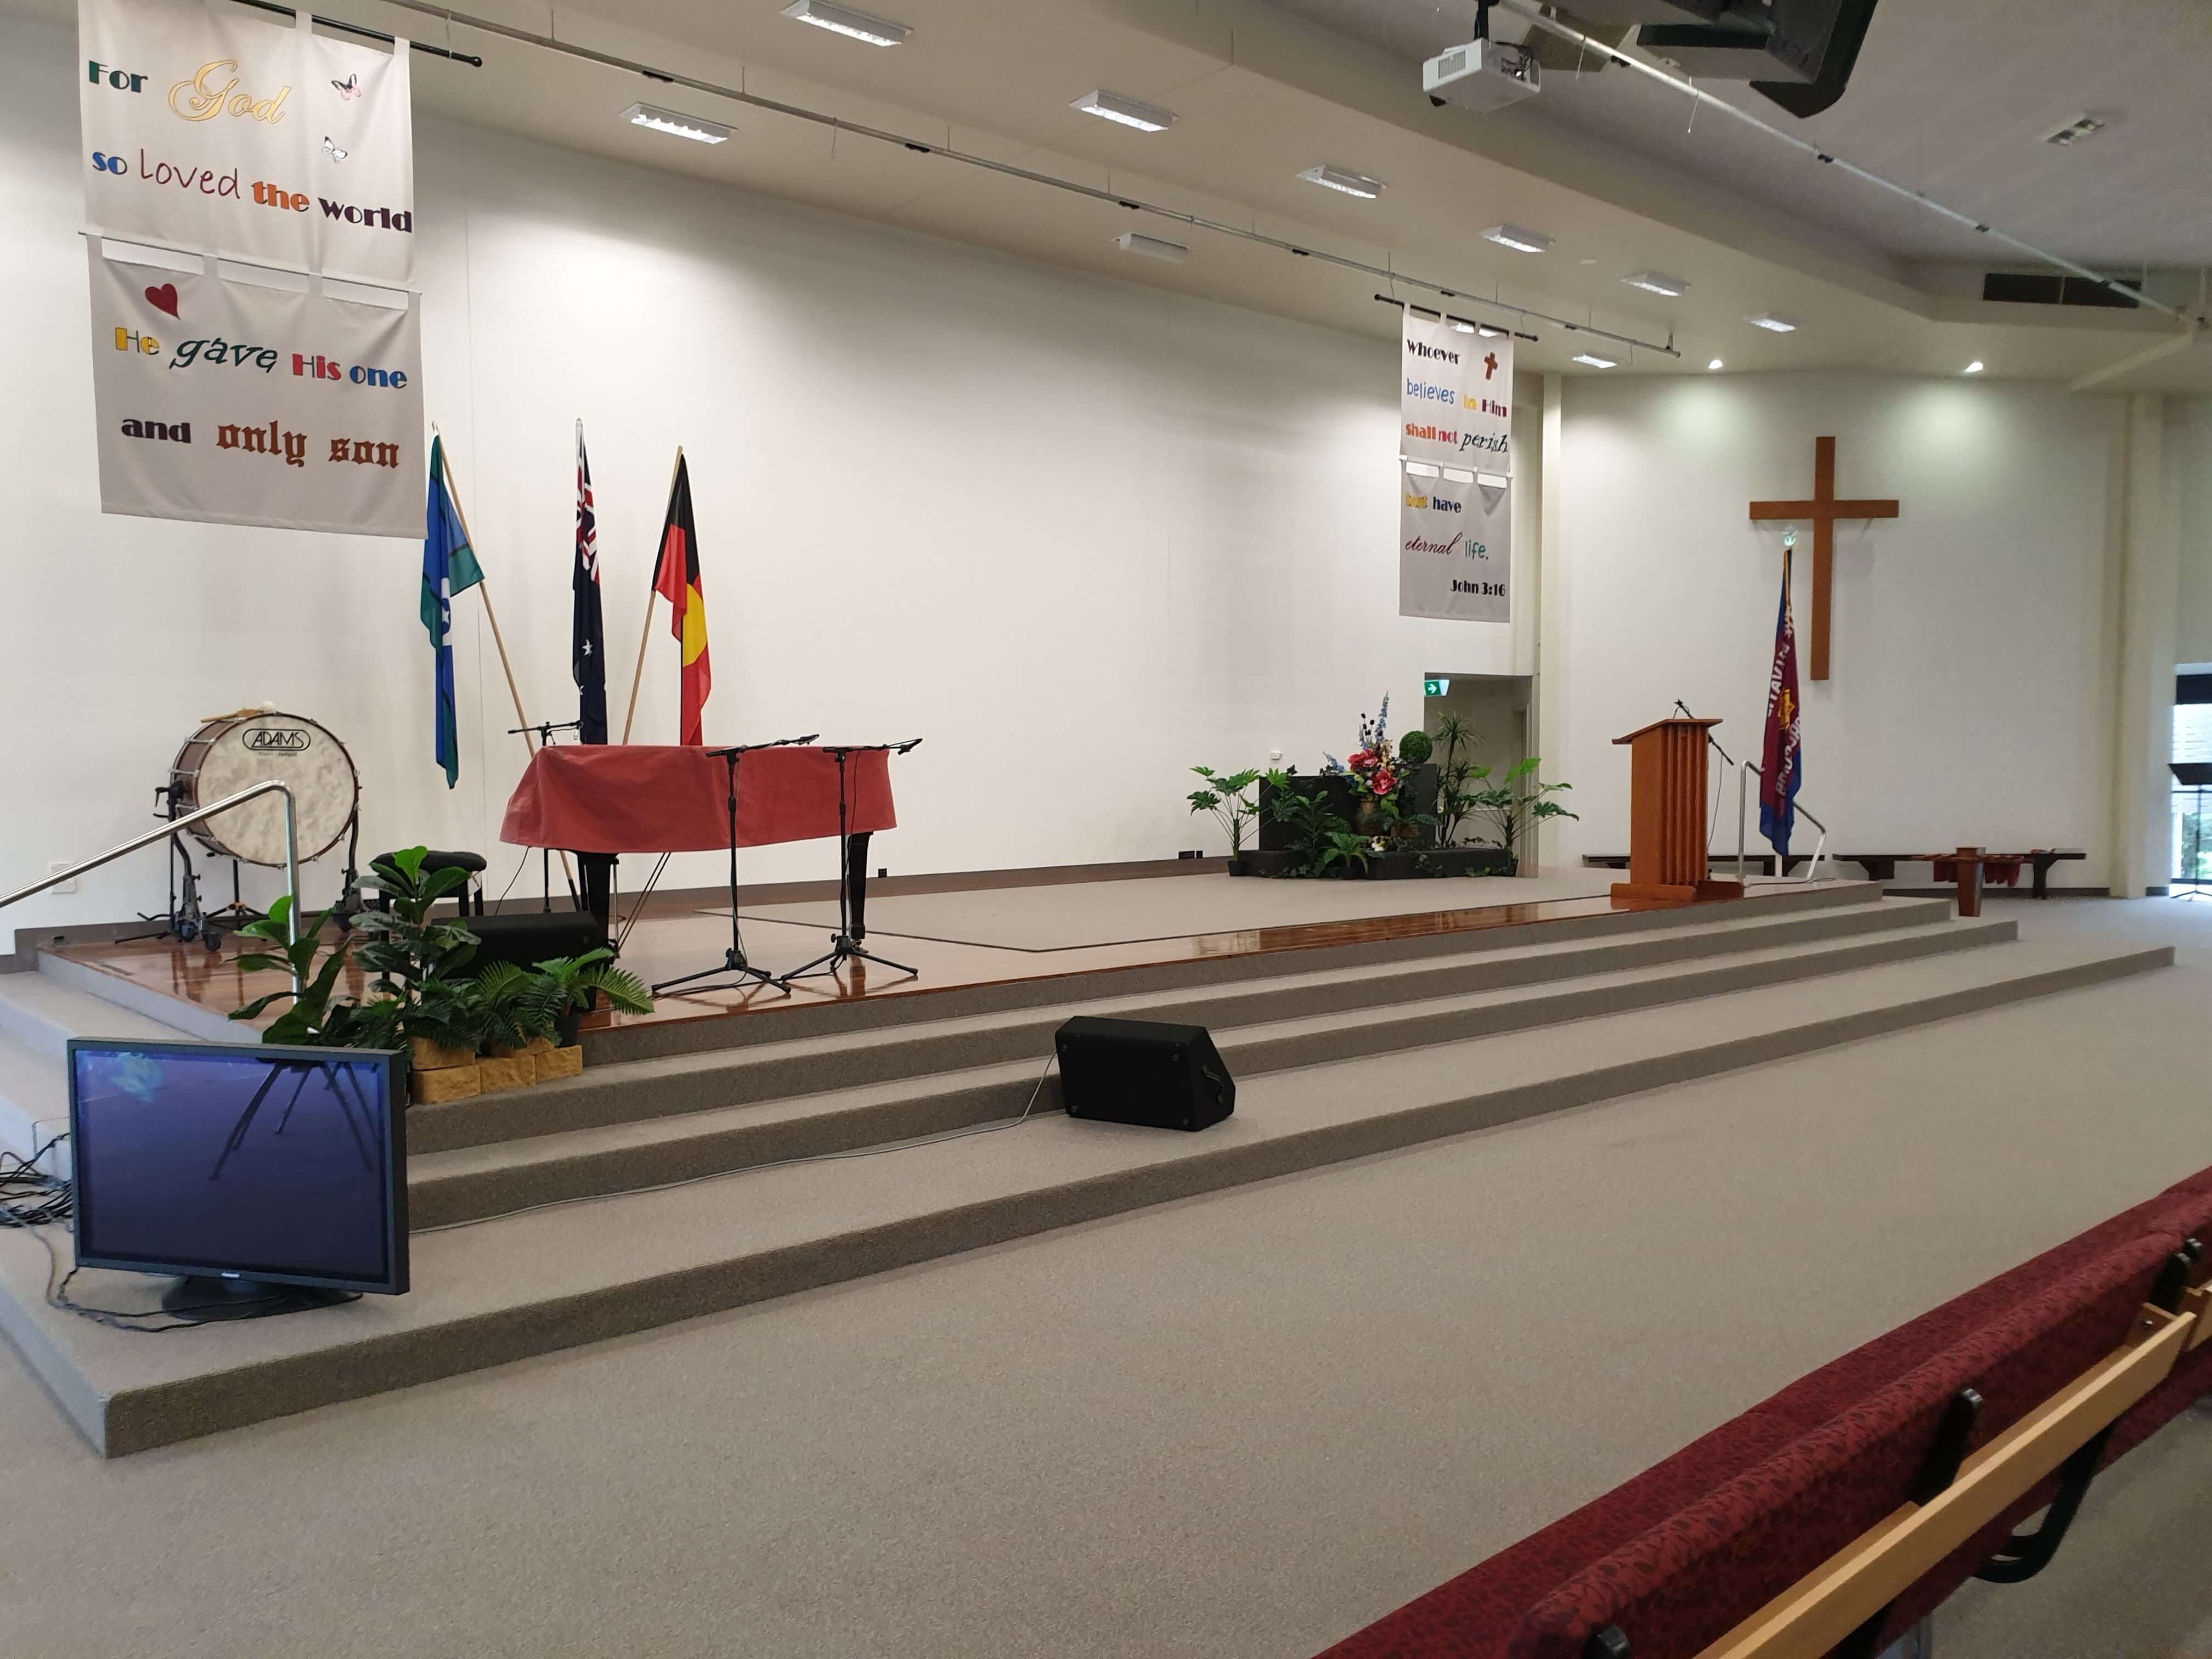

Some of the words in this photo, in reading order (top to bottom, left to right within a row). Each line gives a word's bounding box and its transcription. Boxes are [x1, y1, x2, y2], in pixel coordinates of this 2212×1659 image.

[89, 60, 148, 93] For
[168, 59, 293, 124] God
[93, 152, 127, 175] so
[251, 182, 309, 212] the
[318, 197, 413, 233] world
[115, 327, 159, 355] He
[169, 337, 278, 373] gave
[292, 354, 341, 380] His
[349, 366, 407, 388] one
[1407, 339, 1460, 364] Whoever
[1407, 377, 1454, 404] believes
[1482, 399, 1506, 417] Him
[122, 419, 191, 443] and
[216, 420, 307, 467] only
[329, 438, 399, 469] son
[1406, 423, 1436, 439] shall
[1439, 431, 1458, 444] not
[1459, 433, 1508, 453] perish
[1433, 496, 1461, 513] have
[1406, 532, 1462, 555] eternal
[1451, 580, 1479, 594] John
[1481, 583, 1505, 596] 3:16
[251, 731, 304, 748] ADAMS
